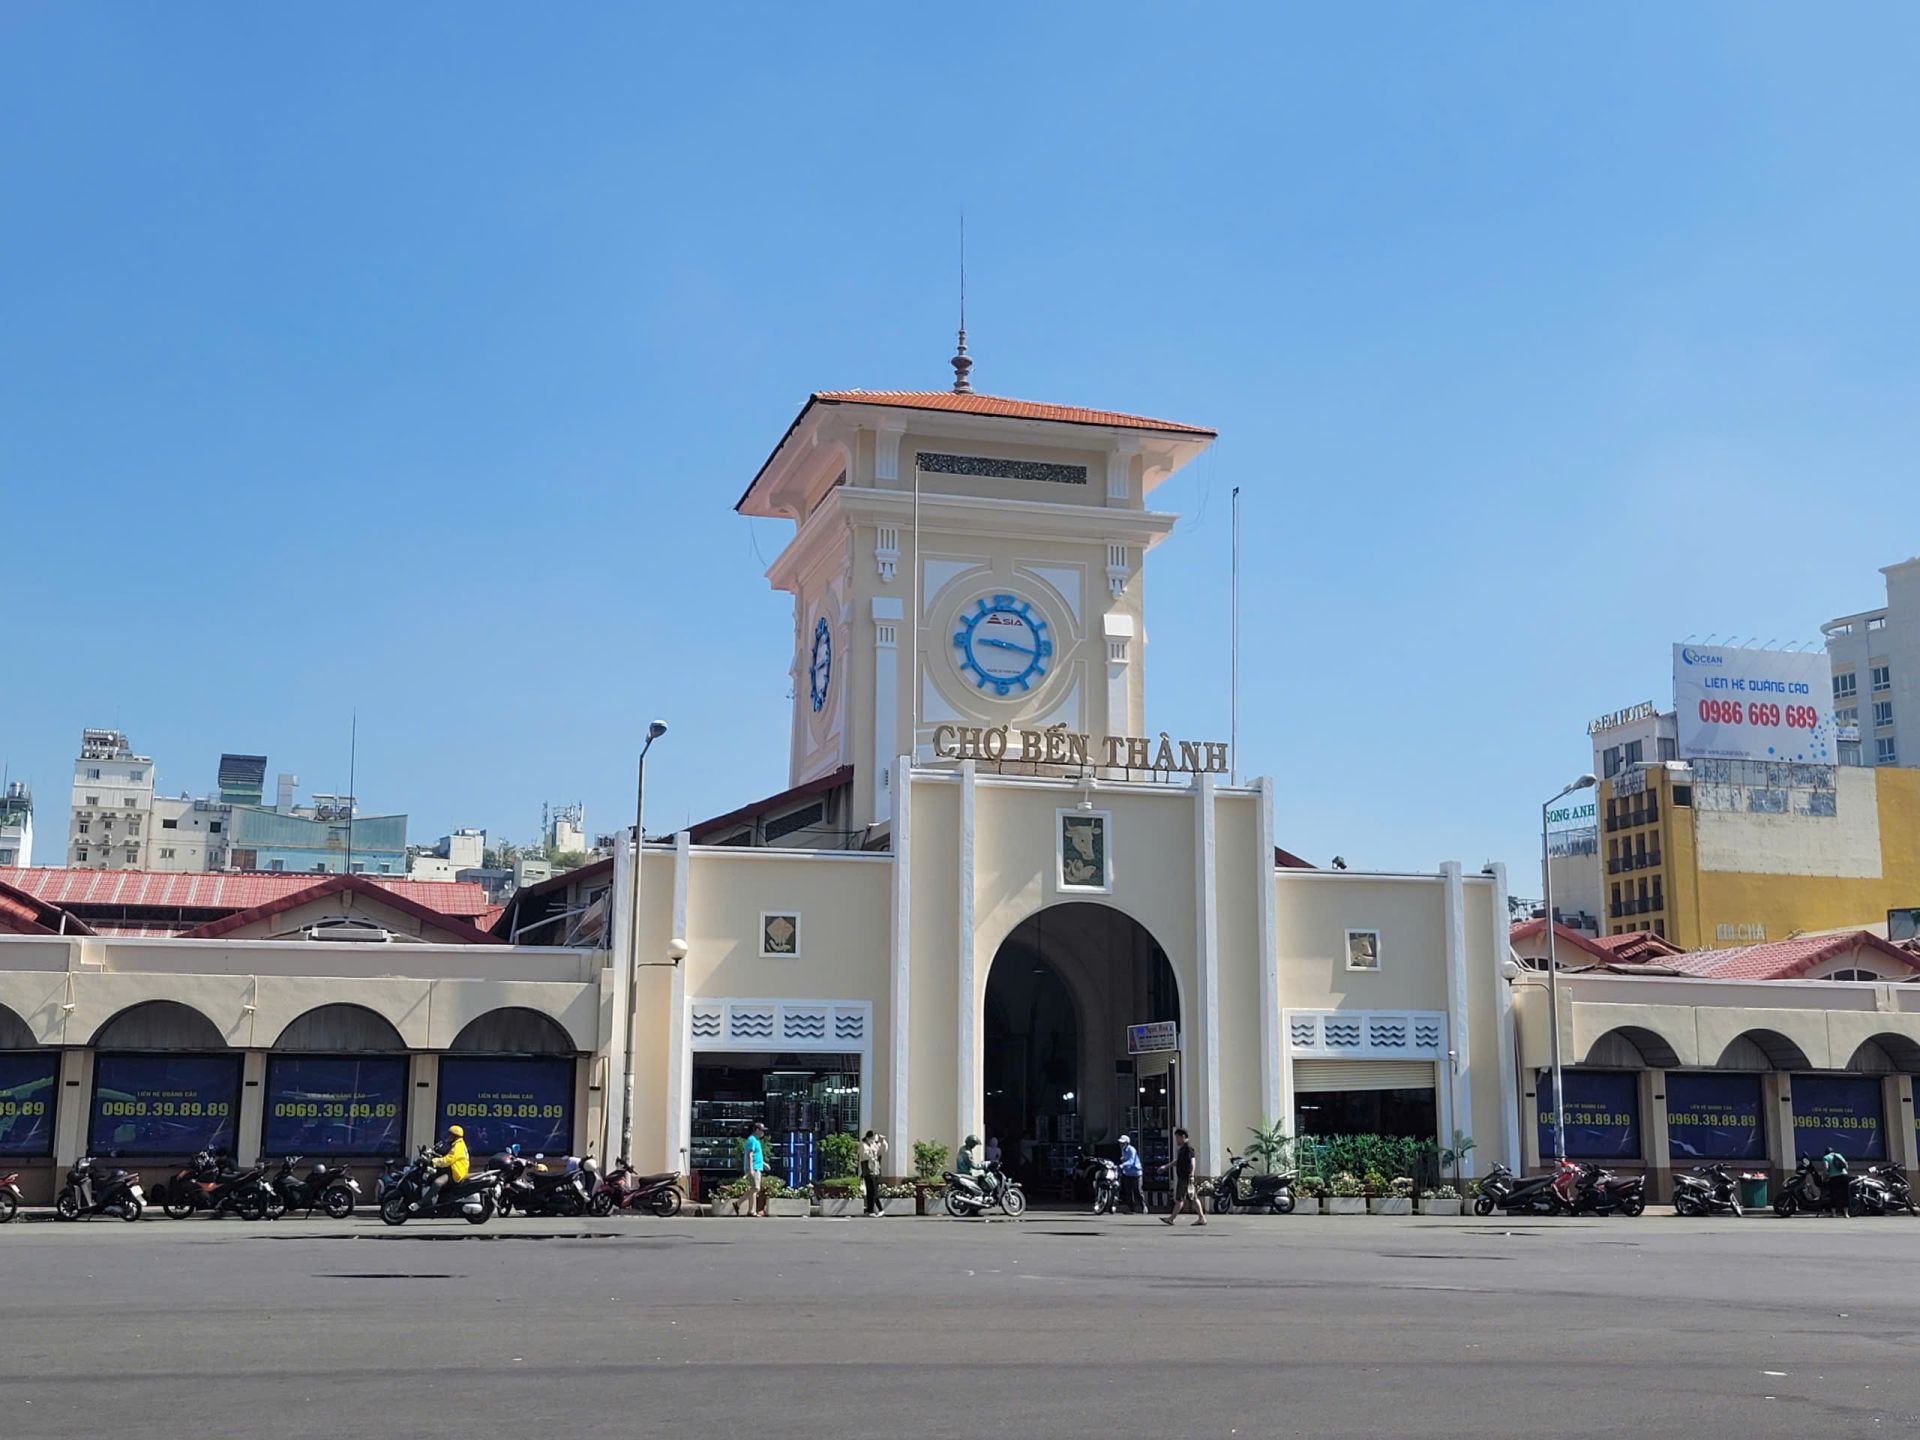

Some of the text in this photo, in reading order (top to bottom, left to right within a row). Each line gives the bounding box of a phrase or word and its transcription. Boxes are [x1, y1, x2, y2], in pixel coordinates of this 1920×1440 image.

[987, 614, 1023, 626] ASIA
[1693, 655, 1723, 664] OCEAN
[1699, 700, 1817, 729] 0986 669 689
[933, 722, 1229, 773] CHỢ BẾN THÀNH
[1572, 803, 1595, 819] ANH
[102, 1102, 229, 1117] 0969.39.89.89
[275, 1103, 397, 1118] 0969.39.89.89
[446, 1103, 564, 1118] 0969.39.89.89
[1540, 1112, 1631, 1126] 099.39.89.89
[1668, 1113, 1757, 1127] 0969.39.89.89
